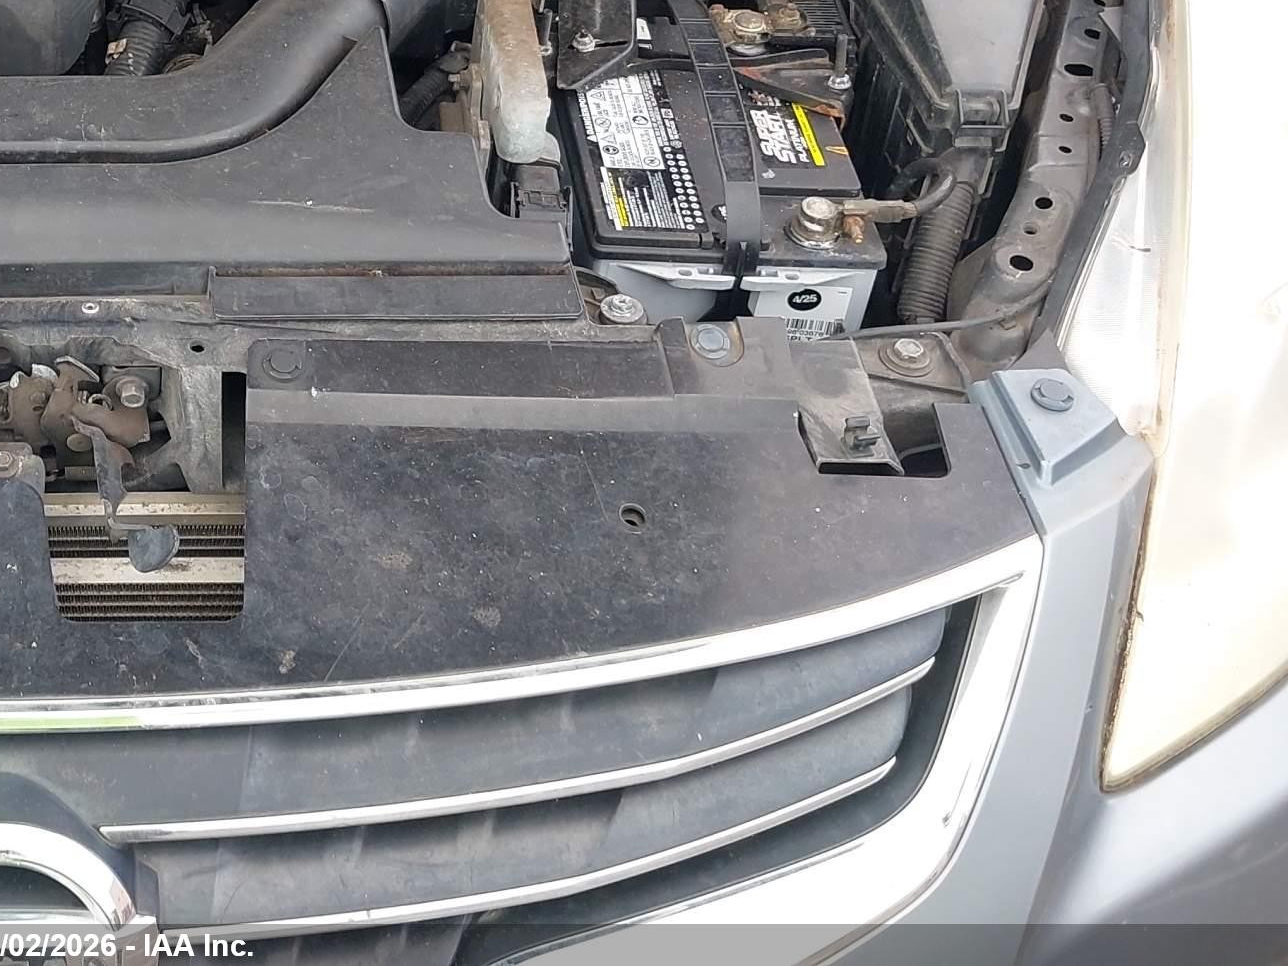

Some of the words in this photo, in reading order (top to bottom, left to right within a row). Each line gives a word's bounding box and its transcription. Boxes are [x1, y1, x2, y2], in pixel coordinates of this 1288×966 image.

[750, 110, 774, 156] SUPER
[767, 112, 798, 164] START
[785, 119, 810, 162] PLATINUM
